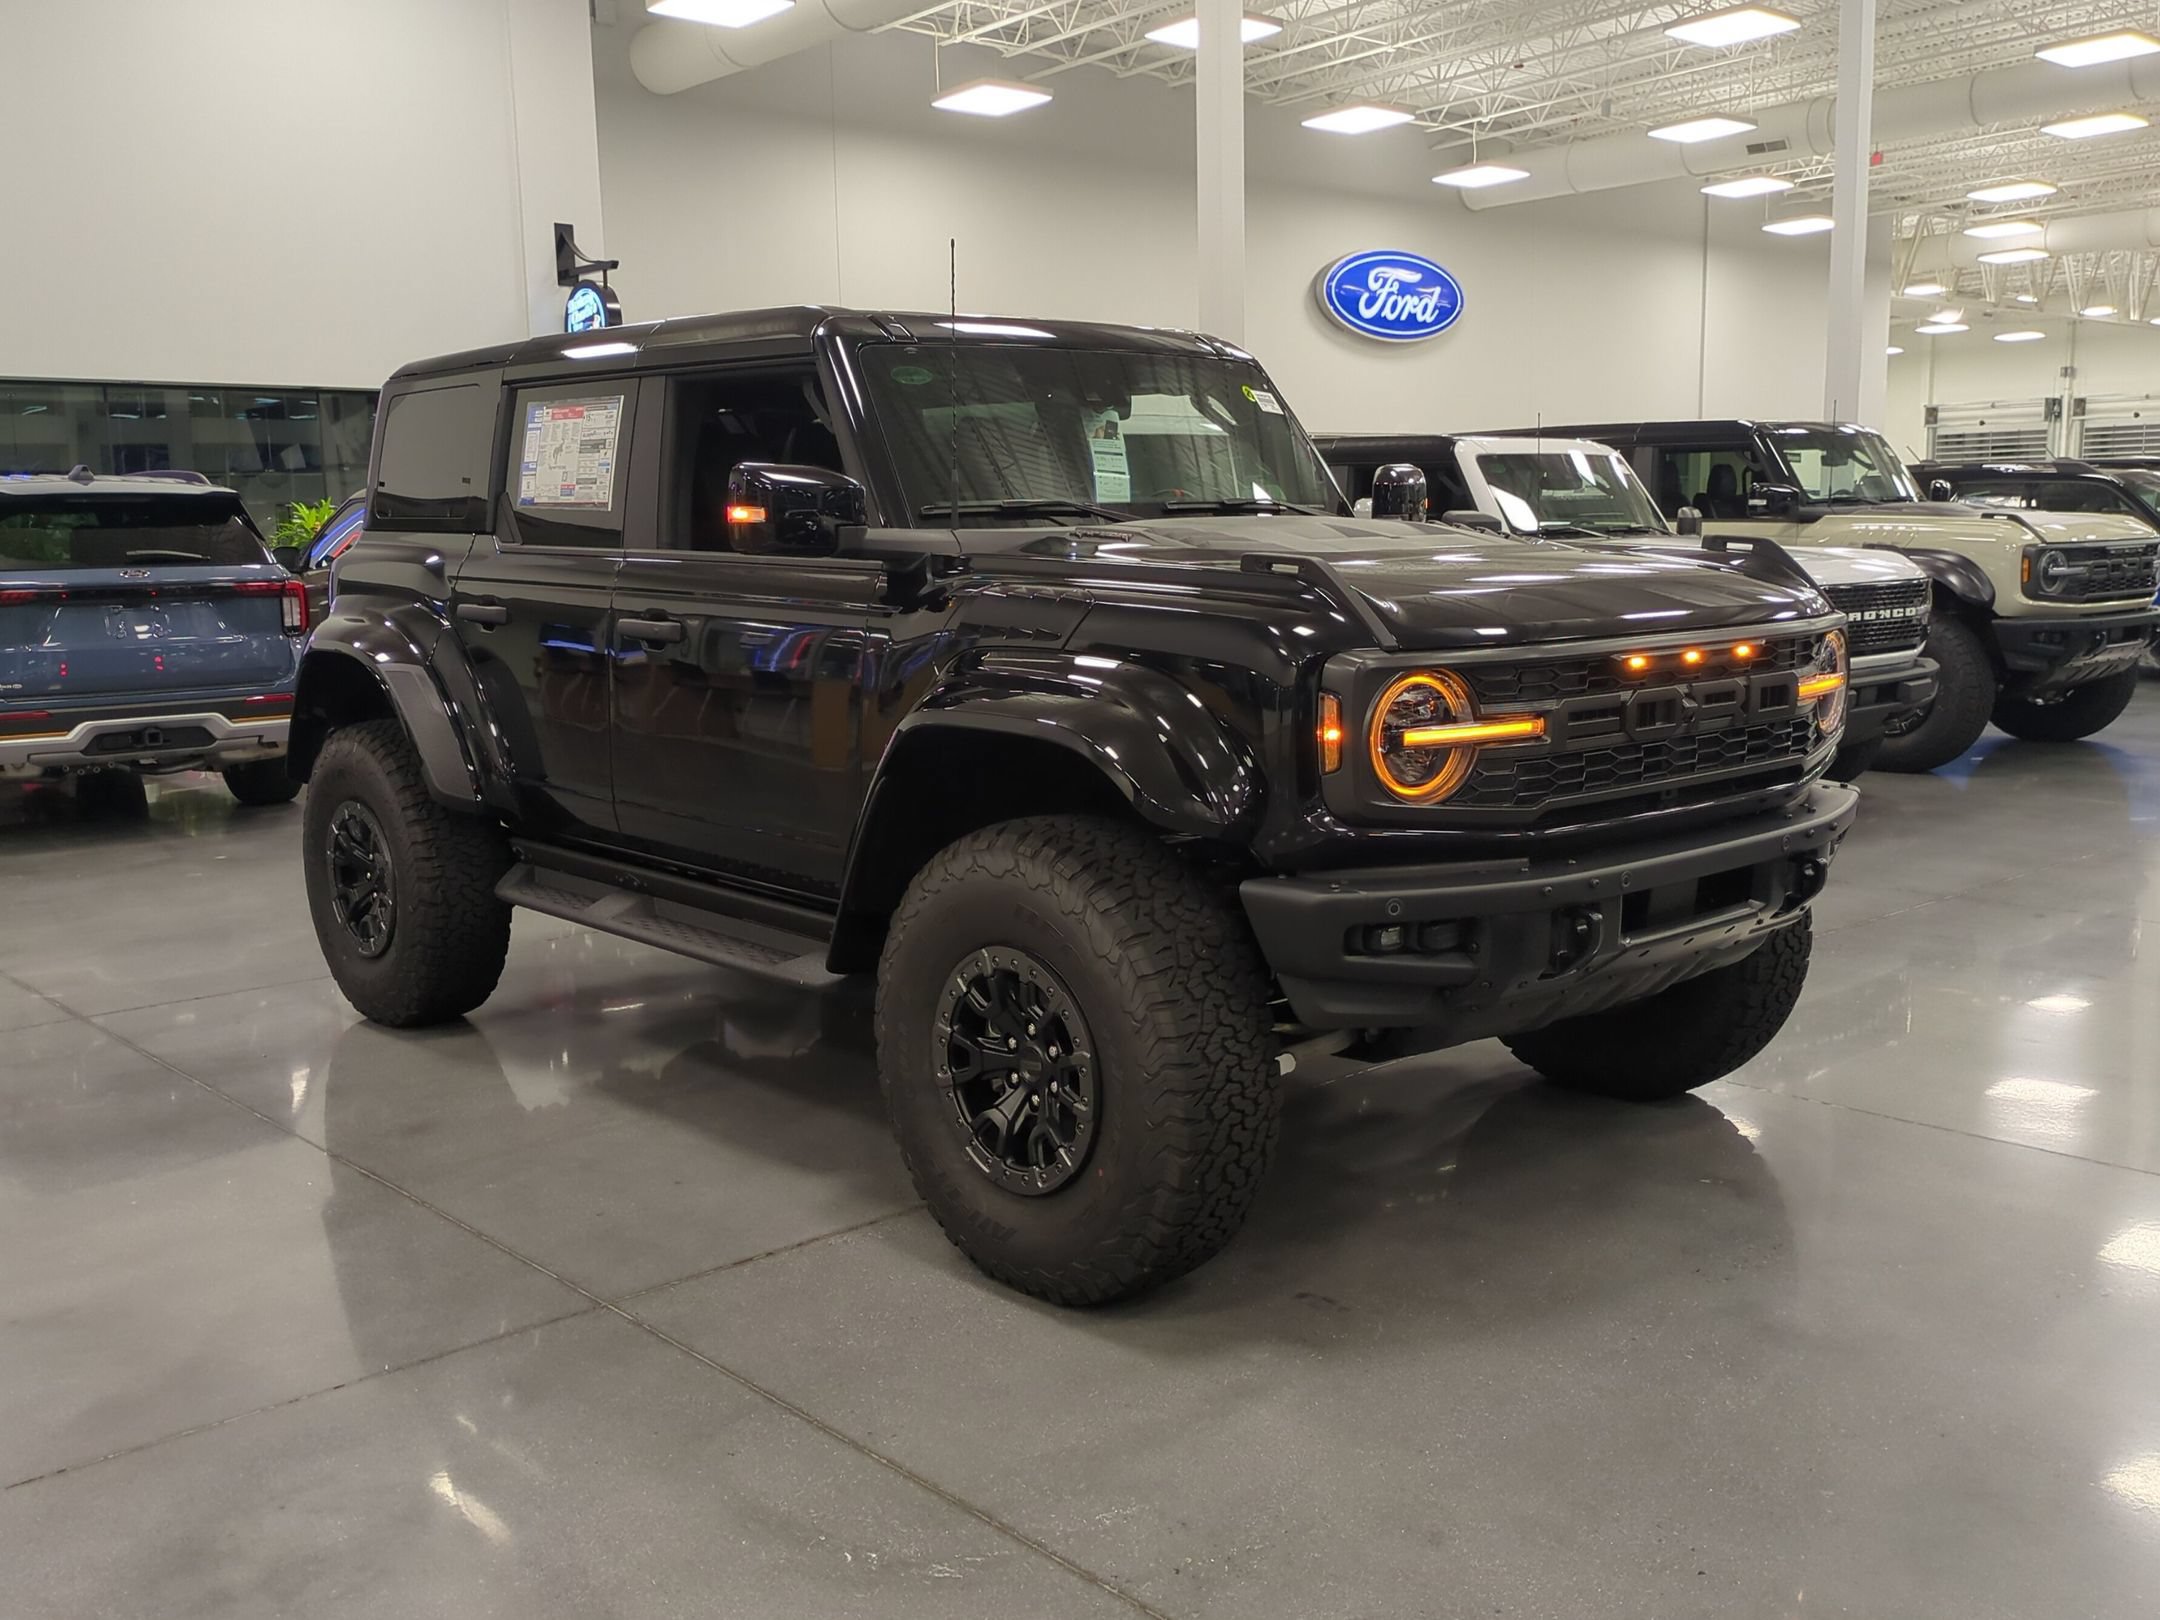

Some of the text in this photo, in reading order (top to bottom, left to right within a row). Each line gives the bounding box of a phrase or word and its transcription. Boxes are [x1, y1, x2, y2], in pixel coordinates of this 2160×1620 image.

[1357, 266, 1442, 324] Ford
[1847, 607, 1917, 622] RONCO
[1556, 669, 1798, 752] FORD
